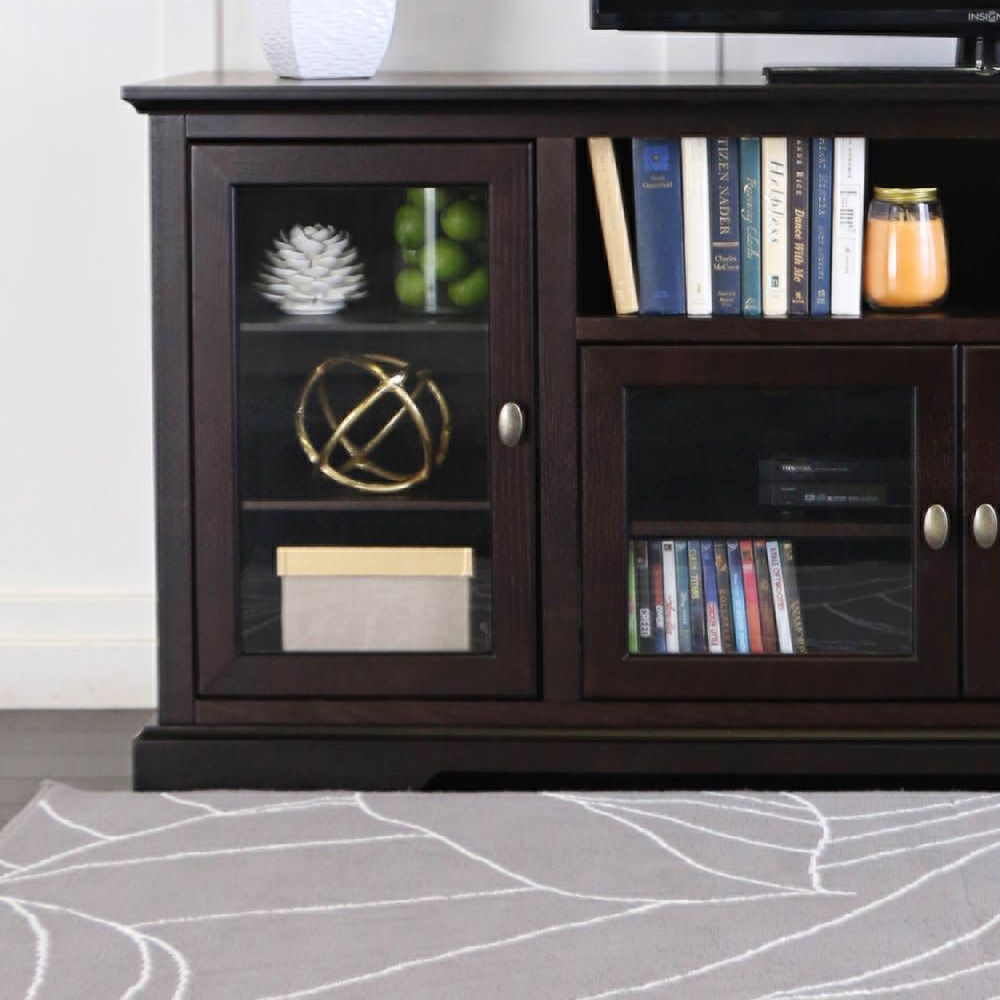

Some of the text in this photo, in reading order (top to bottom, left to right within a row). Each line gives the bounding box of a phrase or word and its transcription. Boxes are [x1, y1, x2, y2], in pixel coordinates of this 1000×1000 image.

[718, 137, 731, 235] TIZEN NADER
[794, 208, 805, 241] Dance
[794, 242, 805, 266] With
[794, 266, 804, 283] Me
[639, 607, 651, 638] CREED
